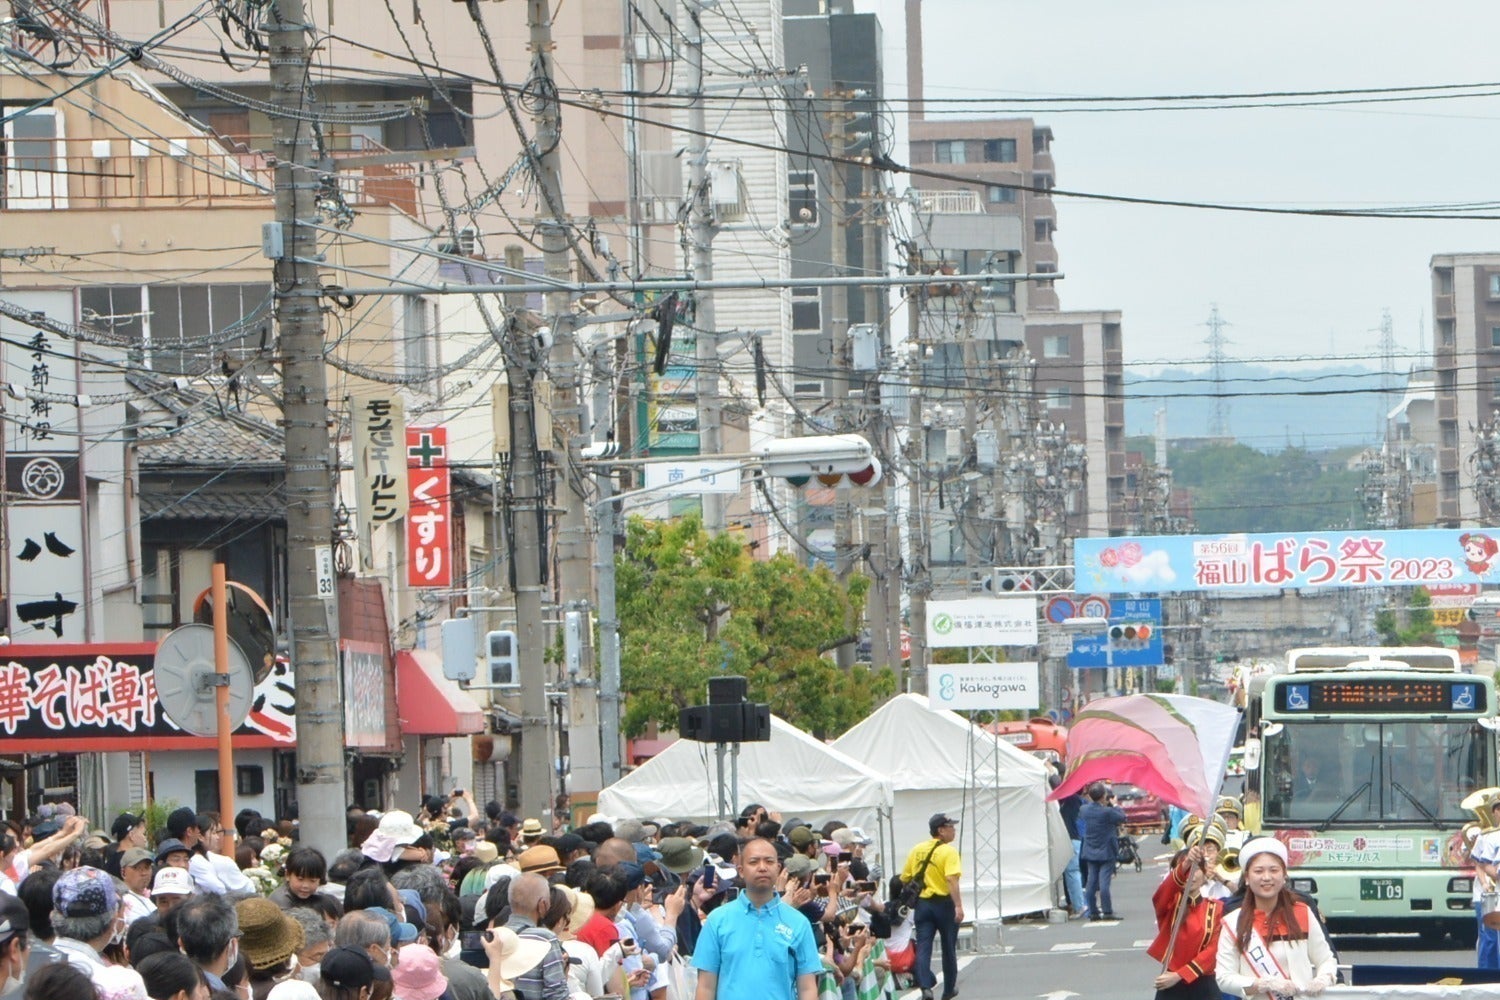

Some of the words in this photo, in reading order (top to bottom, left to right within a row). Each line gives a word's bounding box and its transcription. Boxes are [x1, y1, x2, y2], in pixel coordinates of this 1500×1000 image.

[28, 331, 54, 441] 季節料理
[667, 467, 716, 486] 南町
[411, 476, 444, 580] くすり
[1200, 543, 1239, 554] 第56回
[1391, 559, 1454, 581] 2023
[320, 578, 332, 594] 33
[1086, 603, 1103, 617] 50
[960, 683, 1027, 699] Kakogawa
